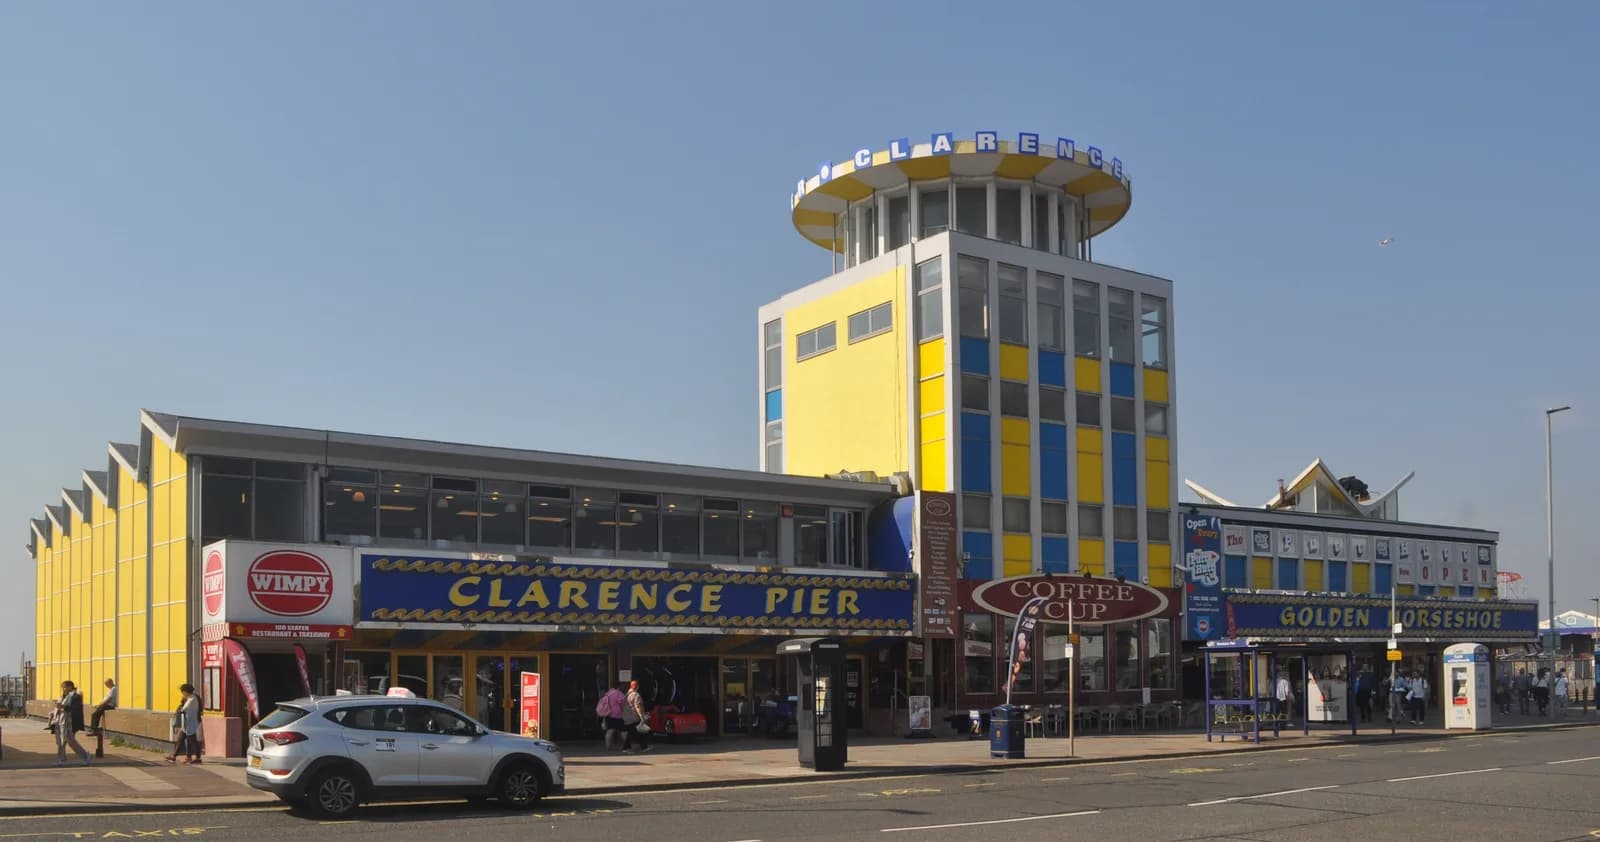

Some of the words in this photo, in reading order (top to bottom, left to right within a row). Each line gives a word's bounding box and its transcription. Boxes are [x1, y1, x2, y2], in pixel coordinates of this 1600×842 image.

[854, 133, 1123, 177] CLARENCE
[1186, 519, 1207, 530] Open
[1226, 534, 1244, 546] The
[251, 573, 330, 593] WIMPY
[1010, 581, 1135, 601] COFFEE
[448, 576, 724, 612] CLARENCE
[766, 587, 861, 616] PIER
[1044, 602, 1107, 620] CUP
[1280, 607, 1370, 628] GOLDEN
[68, 828, 207, 838] TAXIS
